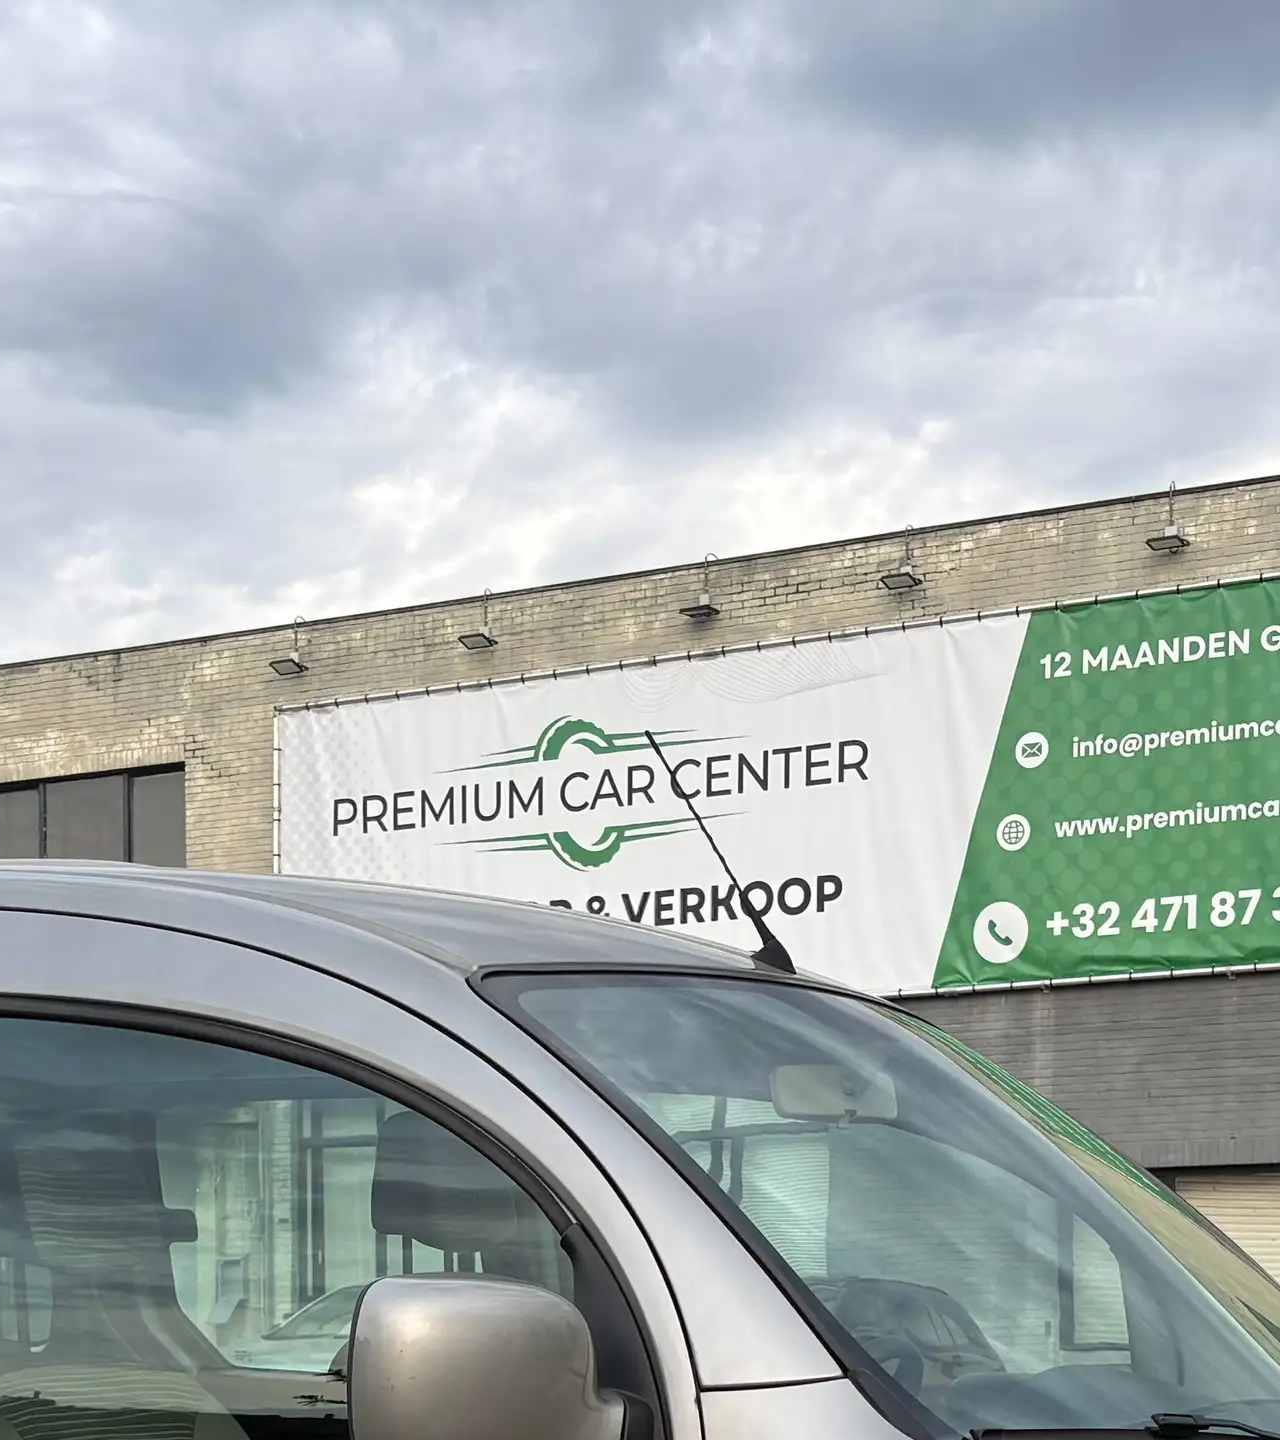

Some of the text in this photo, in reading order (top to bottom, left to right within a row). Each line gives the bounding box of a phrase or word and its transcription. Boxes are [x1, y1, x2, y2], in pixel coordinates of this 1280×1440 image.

[1039, 651, 1072, 679] 12
[1082, 628, 1250, 675] MAANDEN
[332, 739, 869, 837] PREMIUM CAR CENTER
[621, 874, 843, 927] VERKOOP
[1045, 900, 1121, 939] +32
[1131, 894, 1198, 933] 471
[1210, 888, 1262, 929] 87
